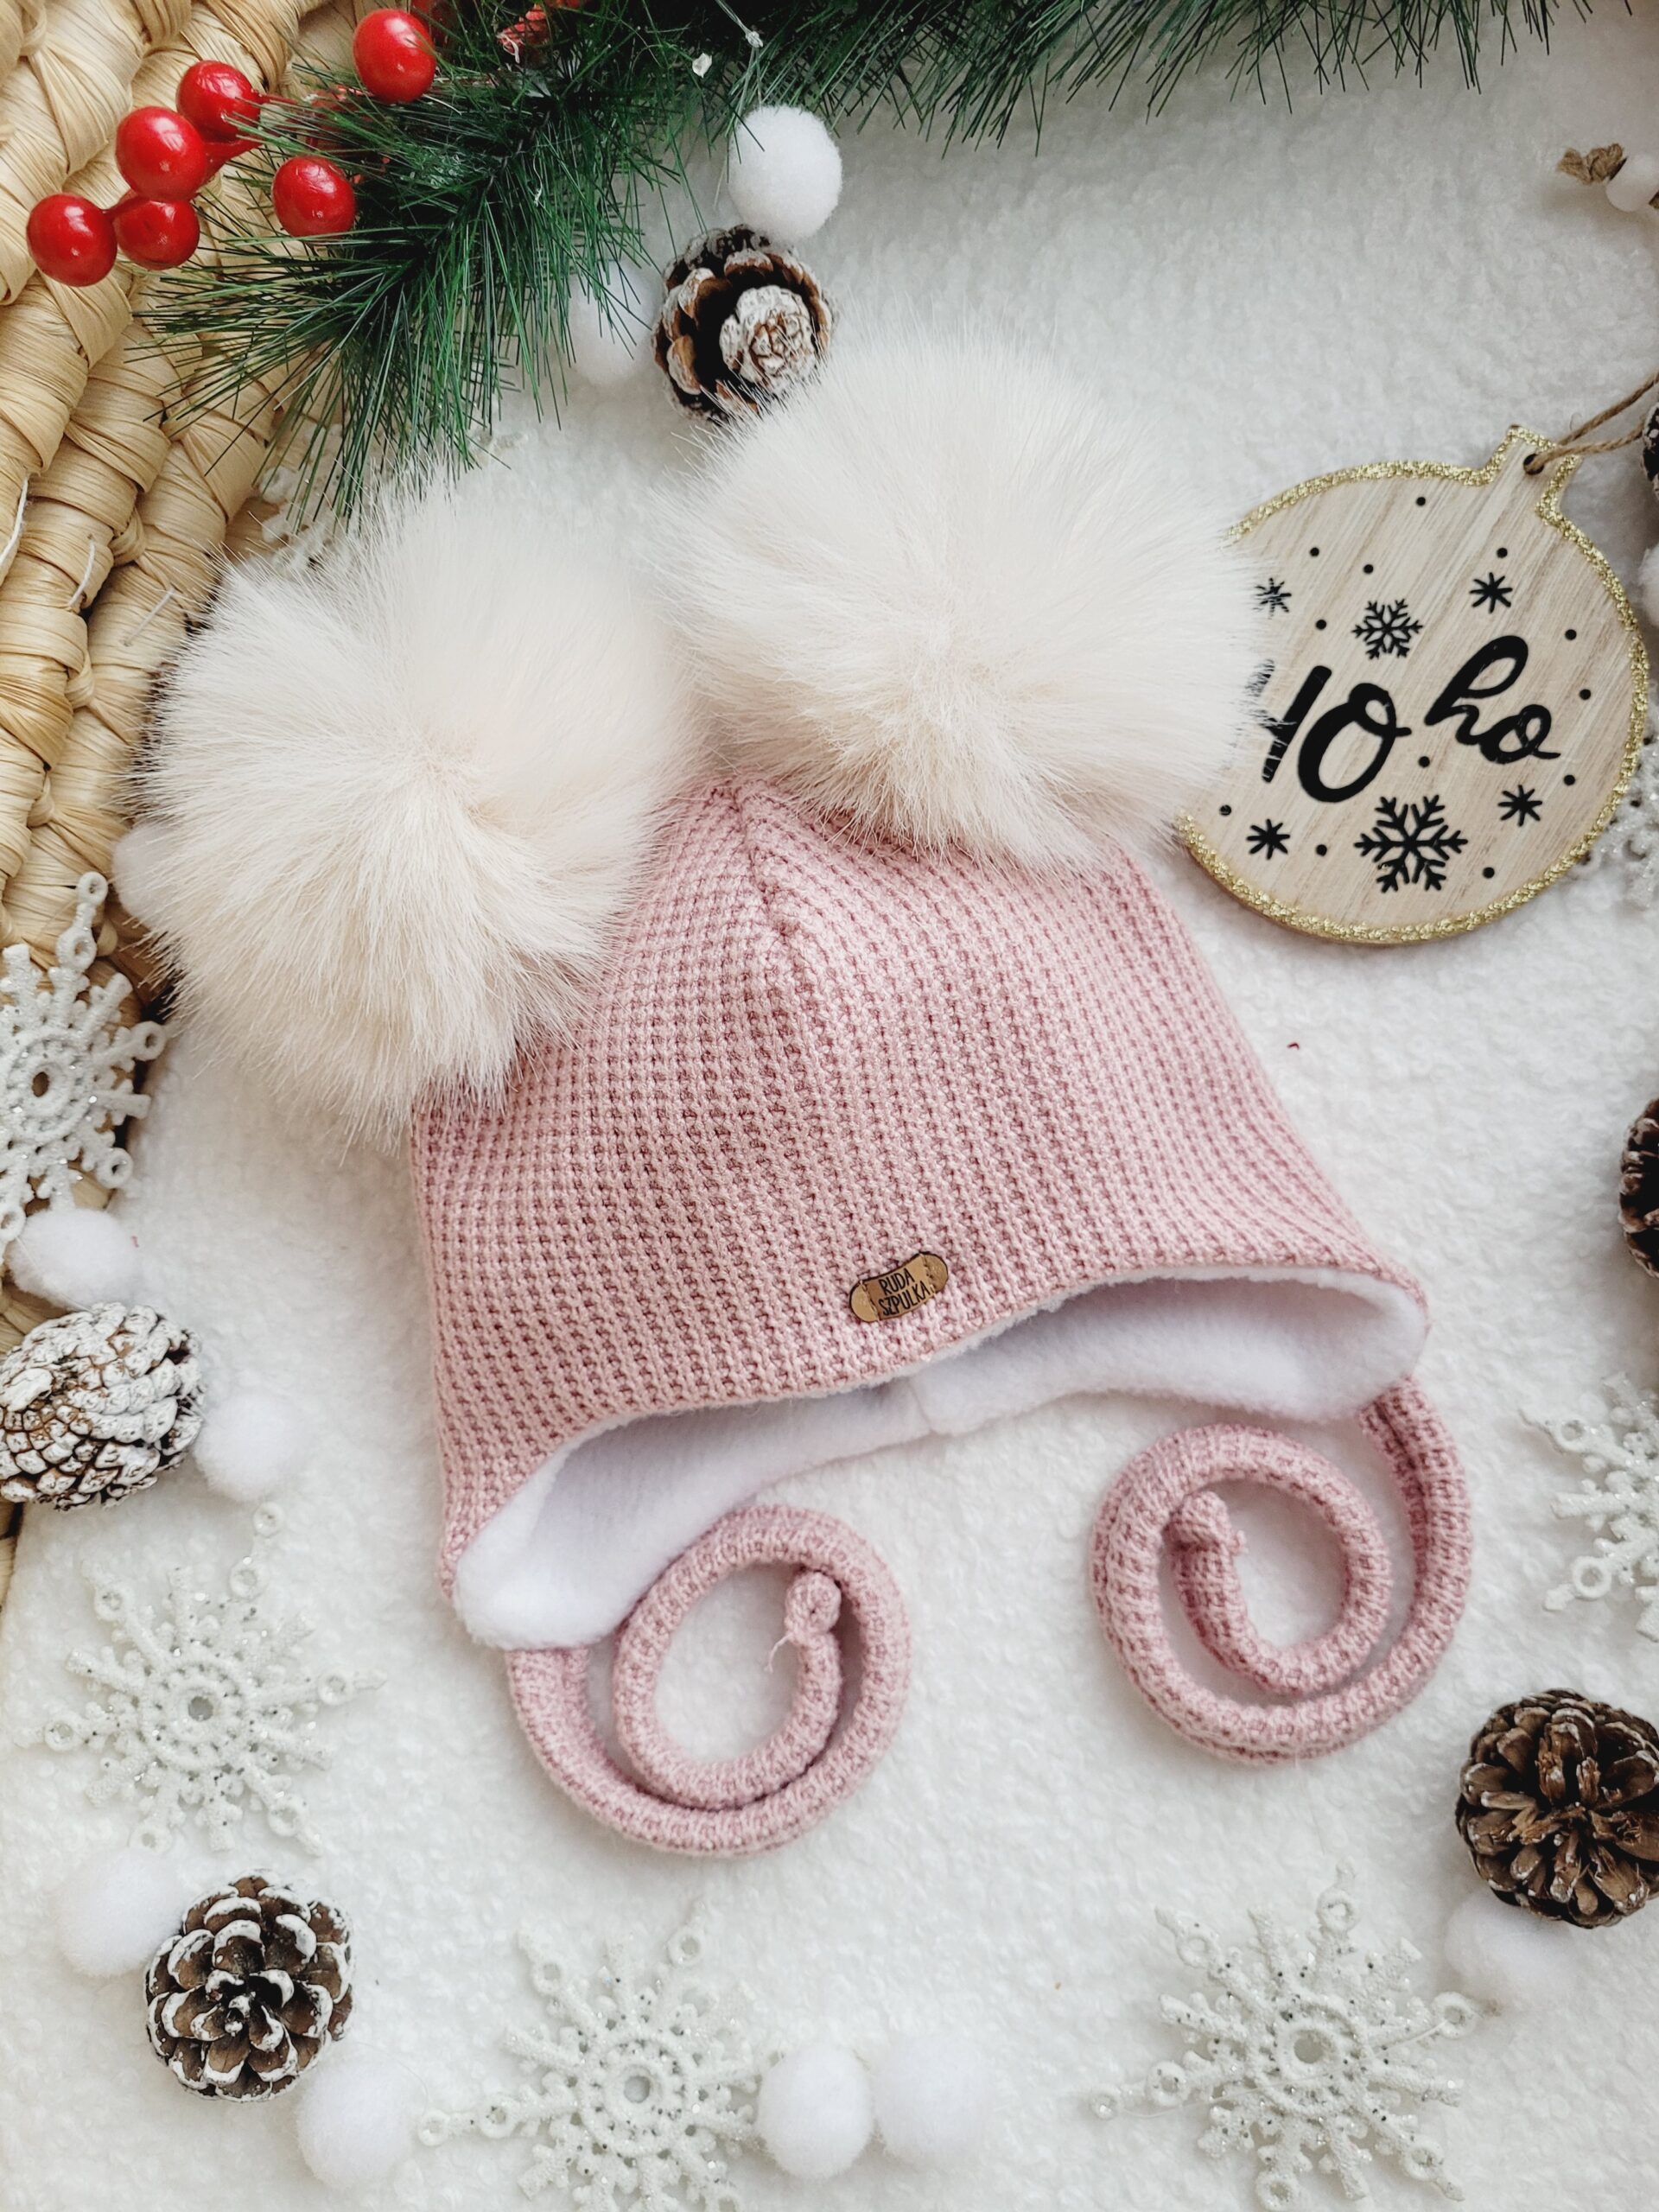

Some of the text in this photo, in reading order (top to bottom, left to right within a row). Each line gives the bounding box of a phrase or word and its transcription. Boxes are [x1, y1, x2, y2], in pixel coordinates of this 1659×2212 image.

[1424, 635, 1560, 764] ho
[878, 1268, 915, 1296] RUDA
[878, 1281, 931, 1316] SZPULKA
